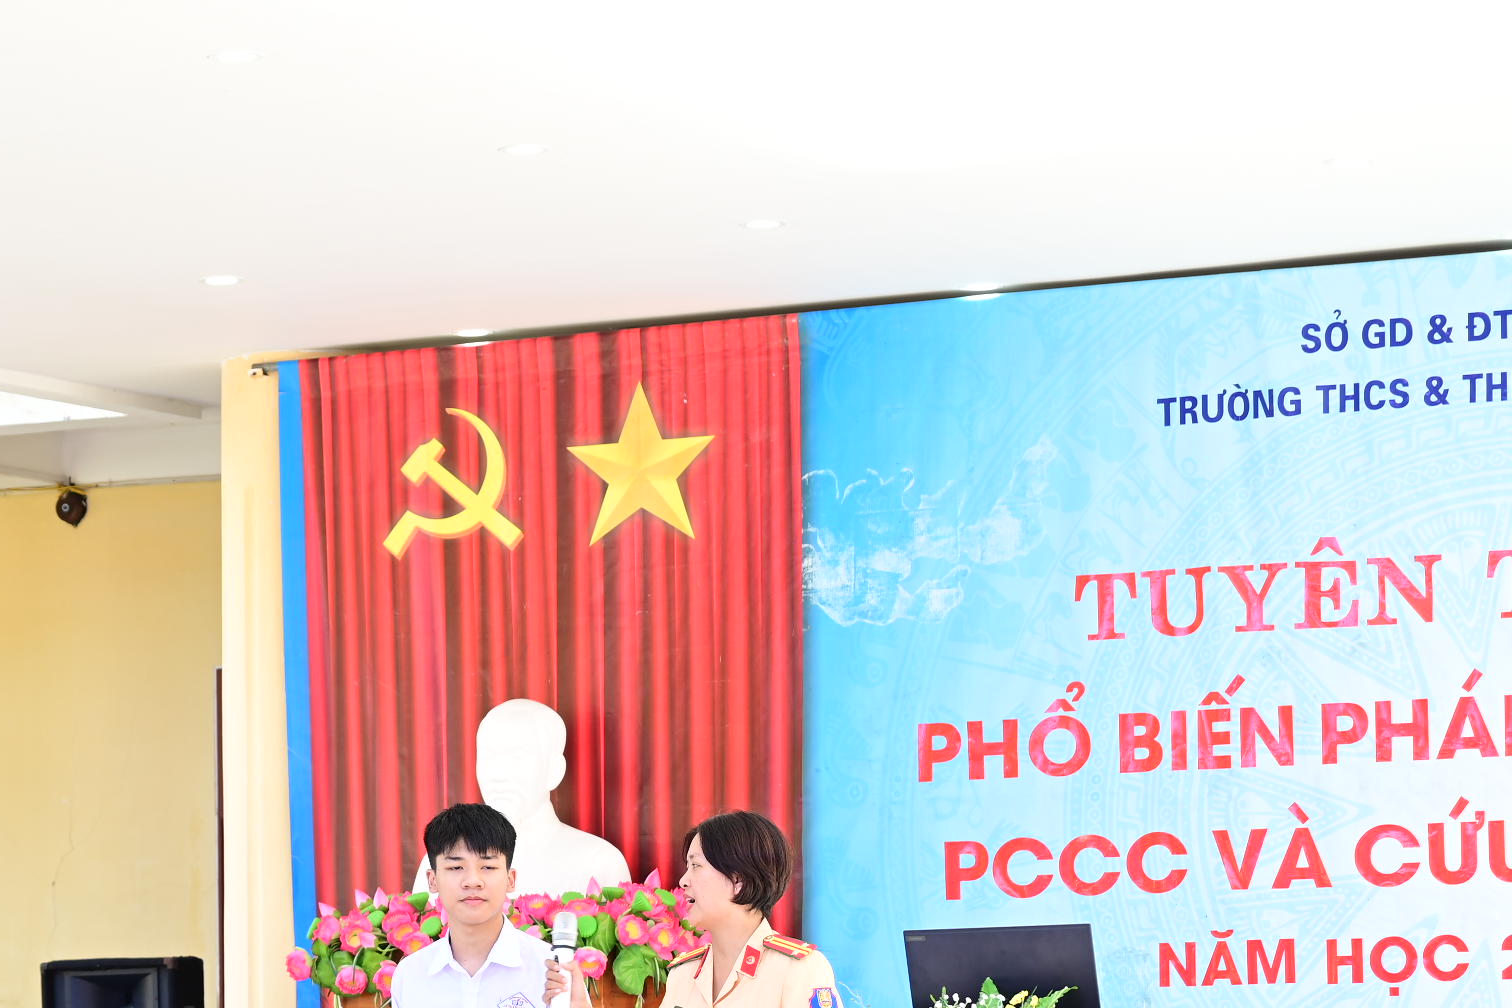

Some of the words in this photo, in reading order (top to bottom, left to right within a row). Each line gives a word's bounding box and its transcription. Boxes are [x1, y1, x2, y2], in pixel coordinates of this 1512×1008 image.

[1301, 309, 1349, 353] SỞ
[1361, 317, 1413, 349] GD
[1427, 314, 1454, 345] &
[1465, 309, 1512, 343] ĐT
[1157, 384, 1303, 427] TRƯỜNG
[1316, 378, 1410, 414] THCS
[1423, 376, 1450, 407] &
[1075, 536, 1443, 641] TUYÊN
[917, 681, 1092, 783] PHỔ
[1119, 674, 1295, 774] BIẾN
[944, 831, 1189, 901] PCCC
[1212, 802, 1333, 891] VÀ
[1159, 929, 1297, 988] NĂM
[1326, 934, 1471, 997] HỌC
